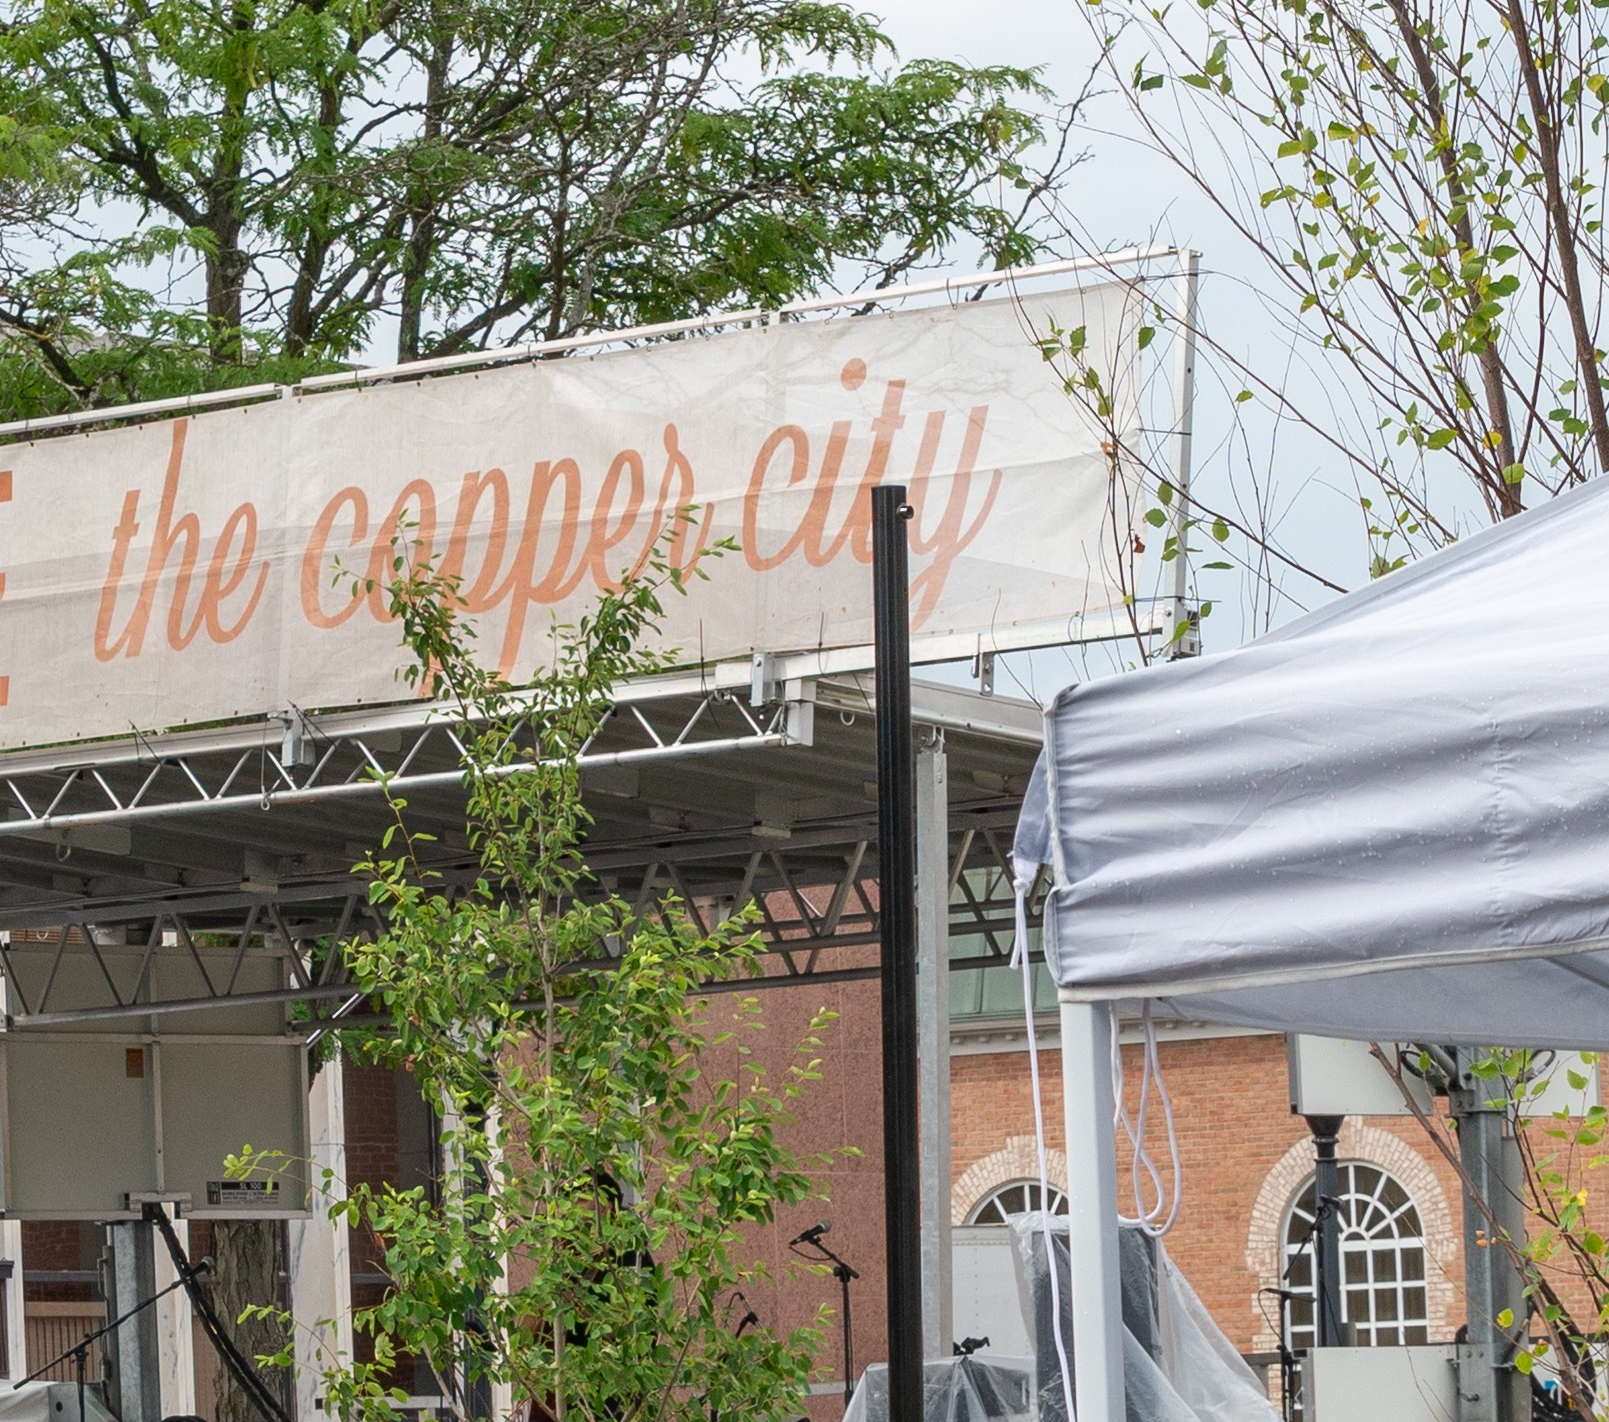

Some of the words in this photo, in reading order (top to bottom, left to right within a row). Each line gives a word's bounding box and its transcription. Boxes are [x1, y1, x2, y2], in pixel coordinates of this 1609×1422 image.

[93, 418, 269, 663] the
[298, 422, 715, 700] copper
[741, 357, 1004, 636] city
